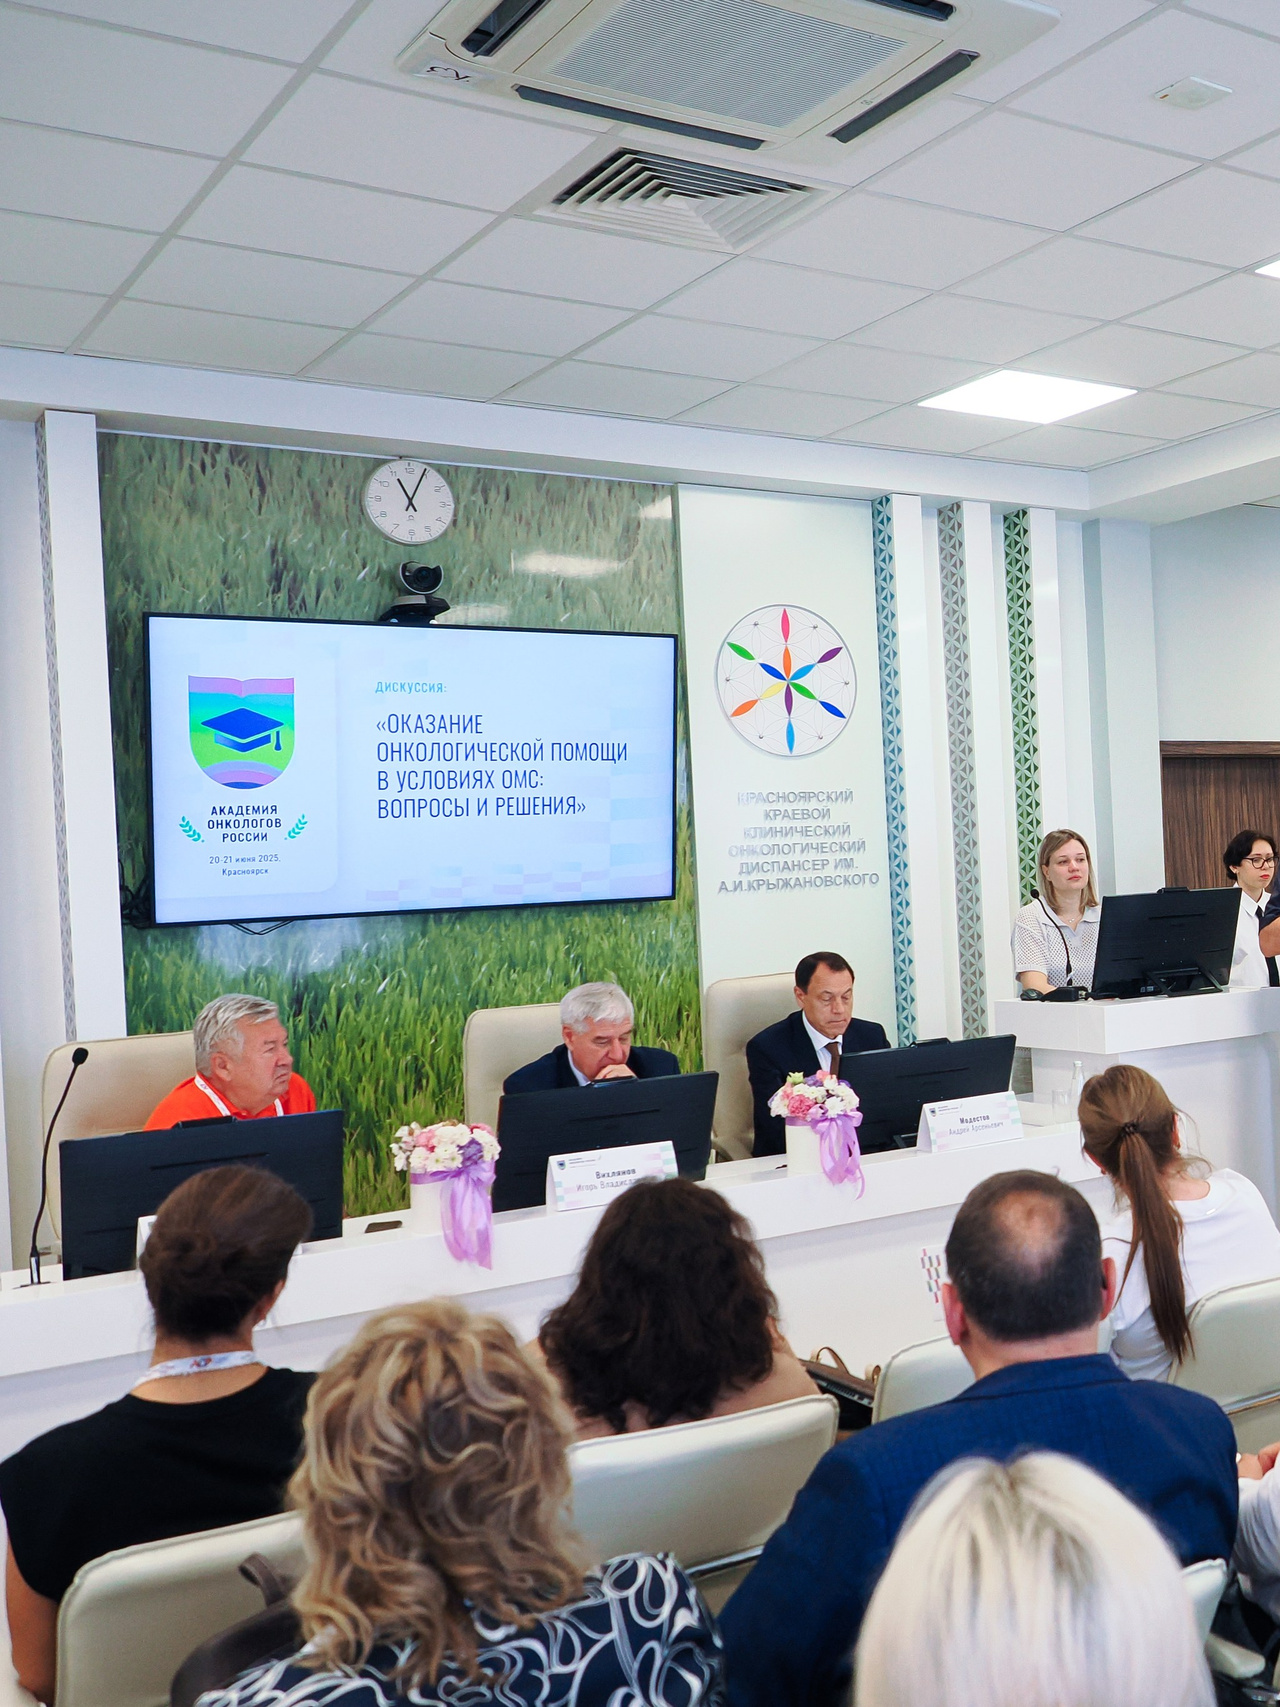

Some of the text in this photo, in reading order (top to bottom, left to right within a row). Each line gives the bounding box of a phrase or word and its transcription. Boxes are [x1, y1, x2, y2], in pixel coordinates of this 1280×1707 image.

[404, 467, 416, 475] 12
[379, 480, 390, 488] 10
[434, 485, 442, 493] 2
[380, 510, 388, 518] 8
[424, 525, 432, 533] 5
[375, 681, 448, 694] ДИСКУССИЯ:
[376, 713, 484, 735] «ОКАЗАНИЕ
[376, 738, 629, 765] ОНКОЛОГИЧЕСКОЙ ПОМОЩИ
[377, 769, 545, 793] В УСЛОВИЯХ ОМС:
[737, 788, 854, 804] КРАСНОЯРСКИЙ
[210, 804, 278, 817] АКАДЕМИЯ
[377, 795, 587, 819] ВОПРОСЫ И РЕШЕНИЯ»
[763, 805, 831, 821] КРАЕВОЙ
[207, 818, 282, 830] ОНКОЛОГОВ
[743, 821, 852, 839] КЛИНИЧЕСКИЙ
[222, 832, 268, 843] РОССИИ
[727, 838, 867, 858] ОНКОЛОГИЧЕСКИЙ
[208, 855, 233, 865] 20-21
[235, 856, 256, 864] июня
[738, 857, 859, 876] ДИСПАНСЕР ИМ.
[222, 868, 269, 877] Красноярск
[718, 873, 879, 893] А.И.КРЫЖАНОВСКОГО
[959, 1115, 990, 1124] Модестов
